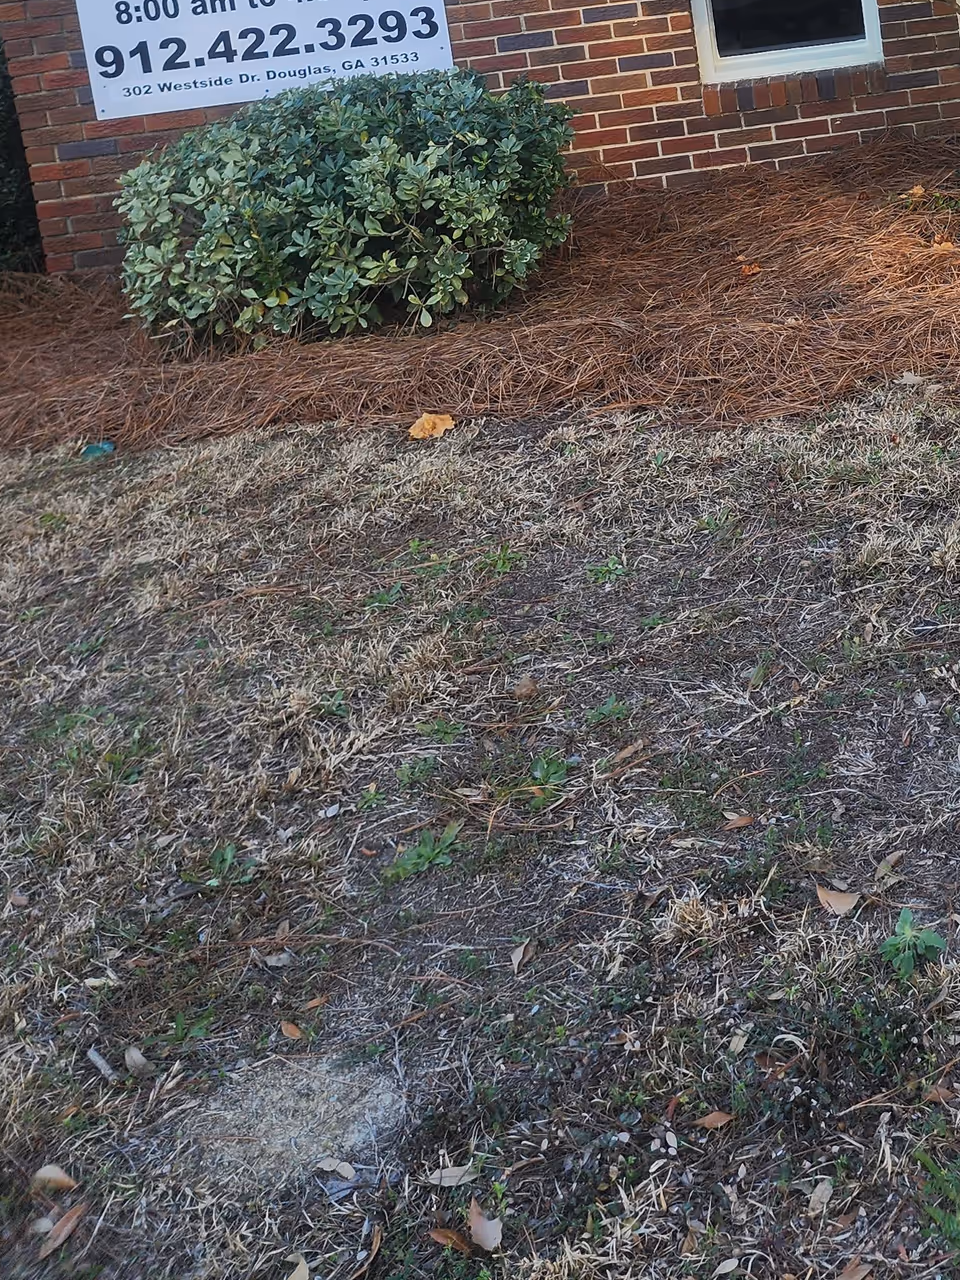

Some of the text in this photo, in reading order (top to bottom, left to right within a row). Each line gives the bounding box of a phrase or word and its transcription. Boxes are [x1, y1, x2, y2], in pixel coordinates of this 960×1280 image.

[94, 6, 440, 79] 912.422.3293
[122, 51, 420, 98] 302 Westside Dr. Douglas, GA 31533
